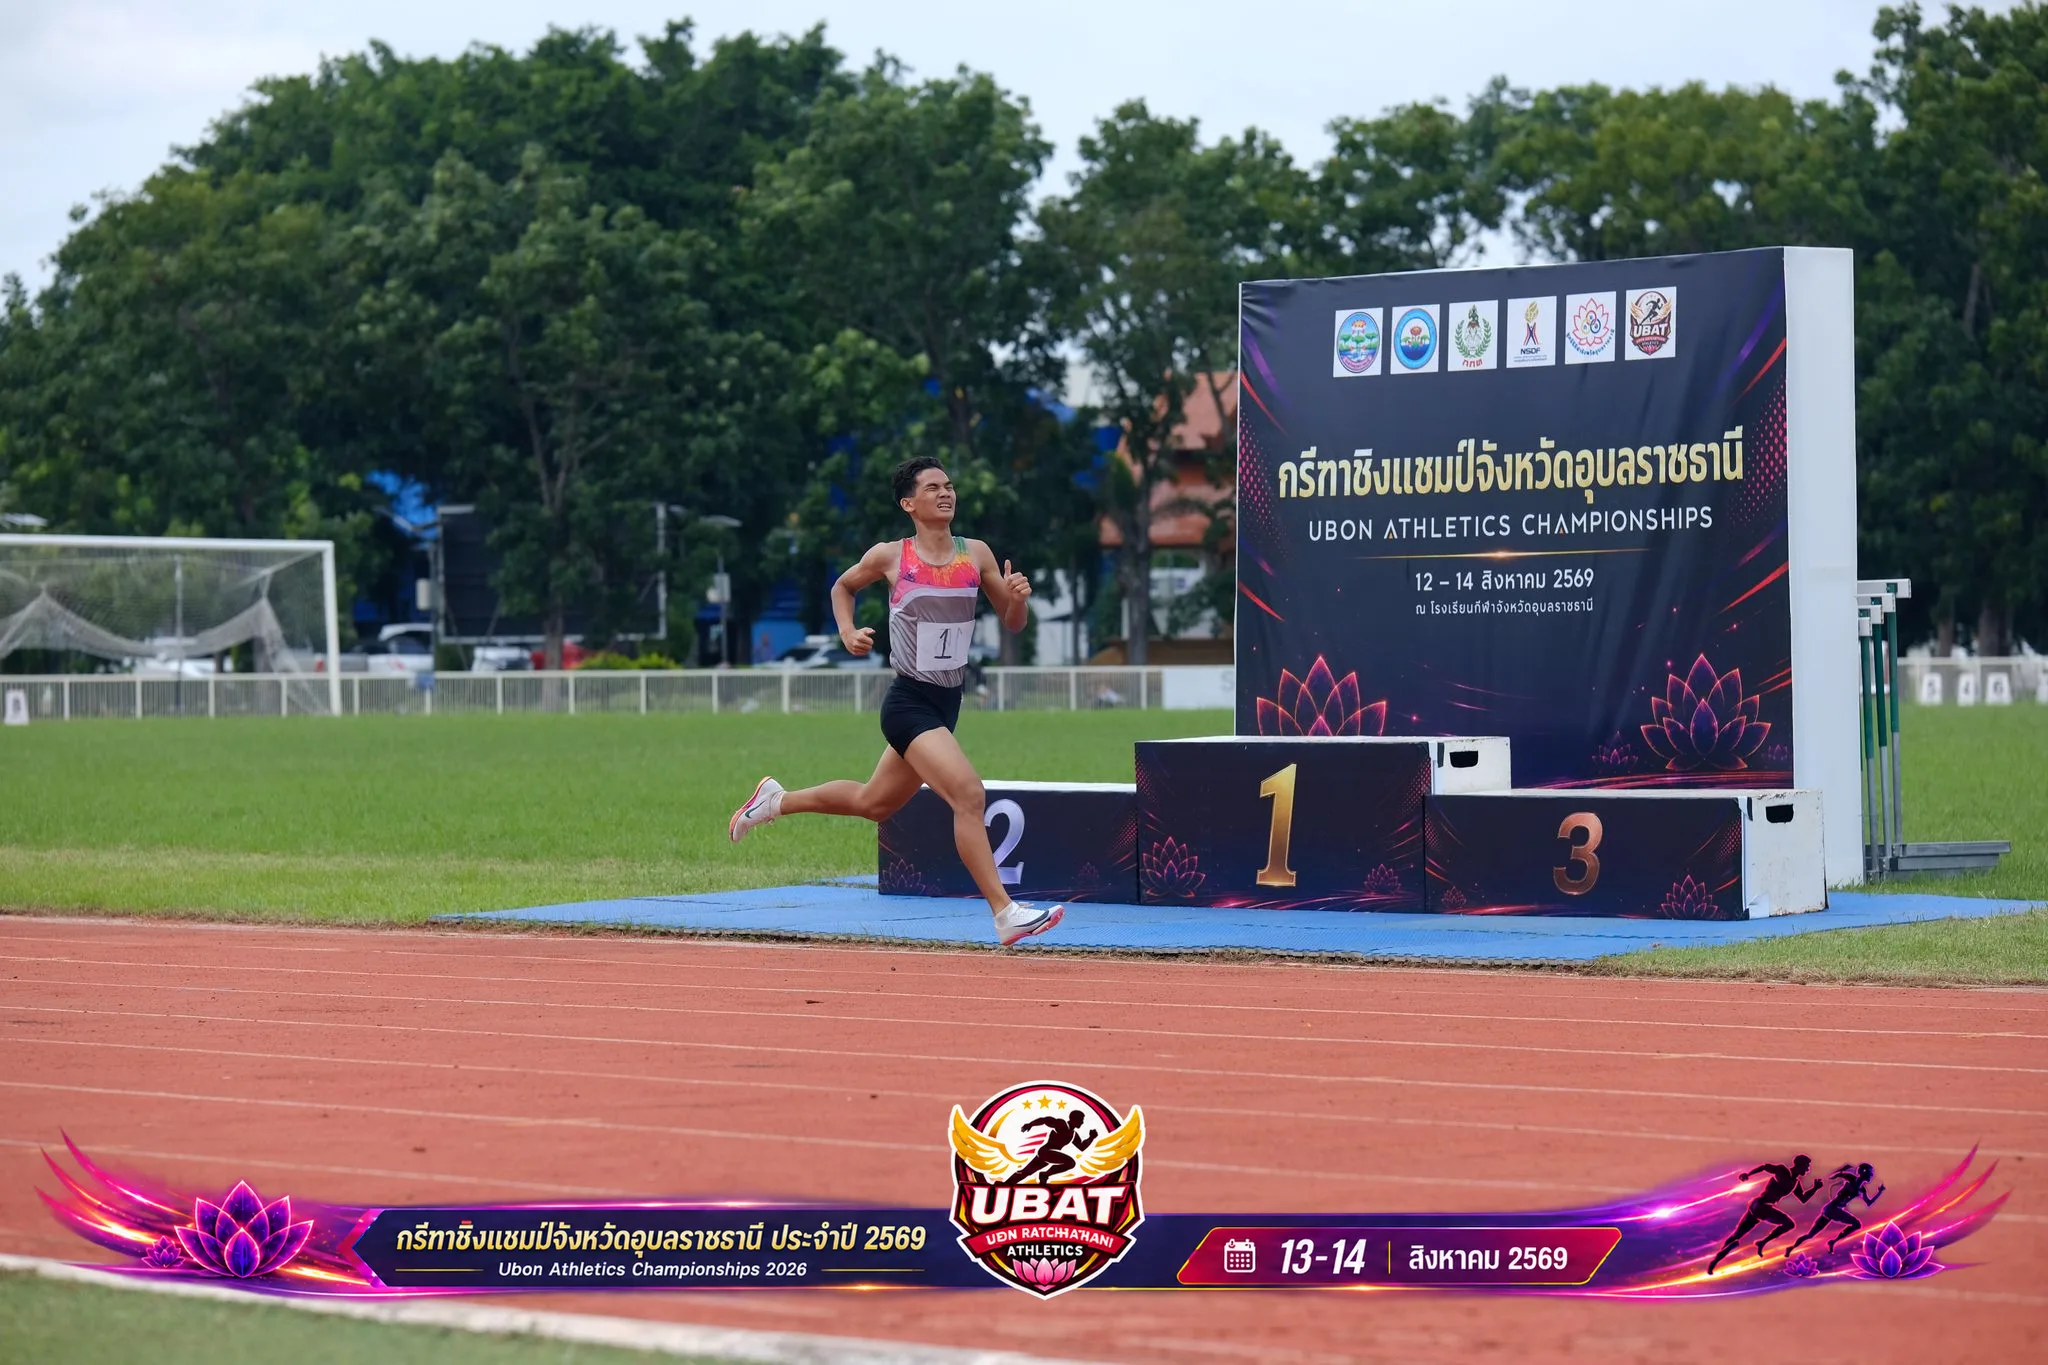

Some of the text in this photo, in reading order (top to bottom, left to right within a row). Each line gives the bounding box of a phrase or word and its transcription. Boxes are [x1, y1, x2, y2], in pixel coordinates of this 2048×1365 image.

[1633, 322, 1669, 338] UBAT
[1520, 347, 1541, 355] NSDF
[1278, 425, 1744, 505] กรีฑาชิงแชมป์จังหวัดอุบลราชธานี
[1309, 506, 1713, 541] UBON ATHLETICS CHAMPIONSHIPS
[1415, 573, 1433, 591] 12
[1456, 572, 1474, 590] 14
[1481, 570, 1546, 590] สิงหาคม
[1553, 568, 1594, 588] 2569
[1415, 597, 1594, 617] ณ โรงเรียนกีฬาจังหวัดอุบลราชธานี
[934, 628, 952, 659] 1
[983, 799, 1025, 884] 2
[1255, 763, 1298, 887] 1
[1553, 811, 1604, 896] 3
